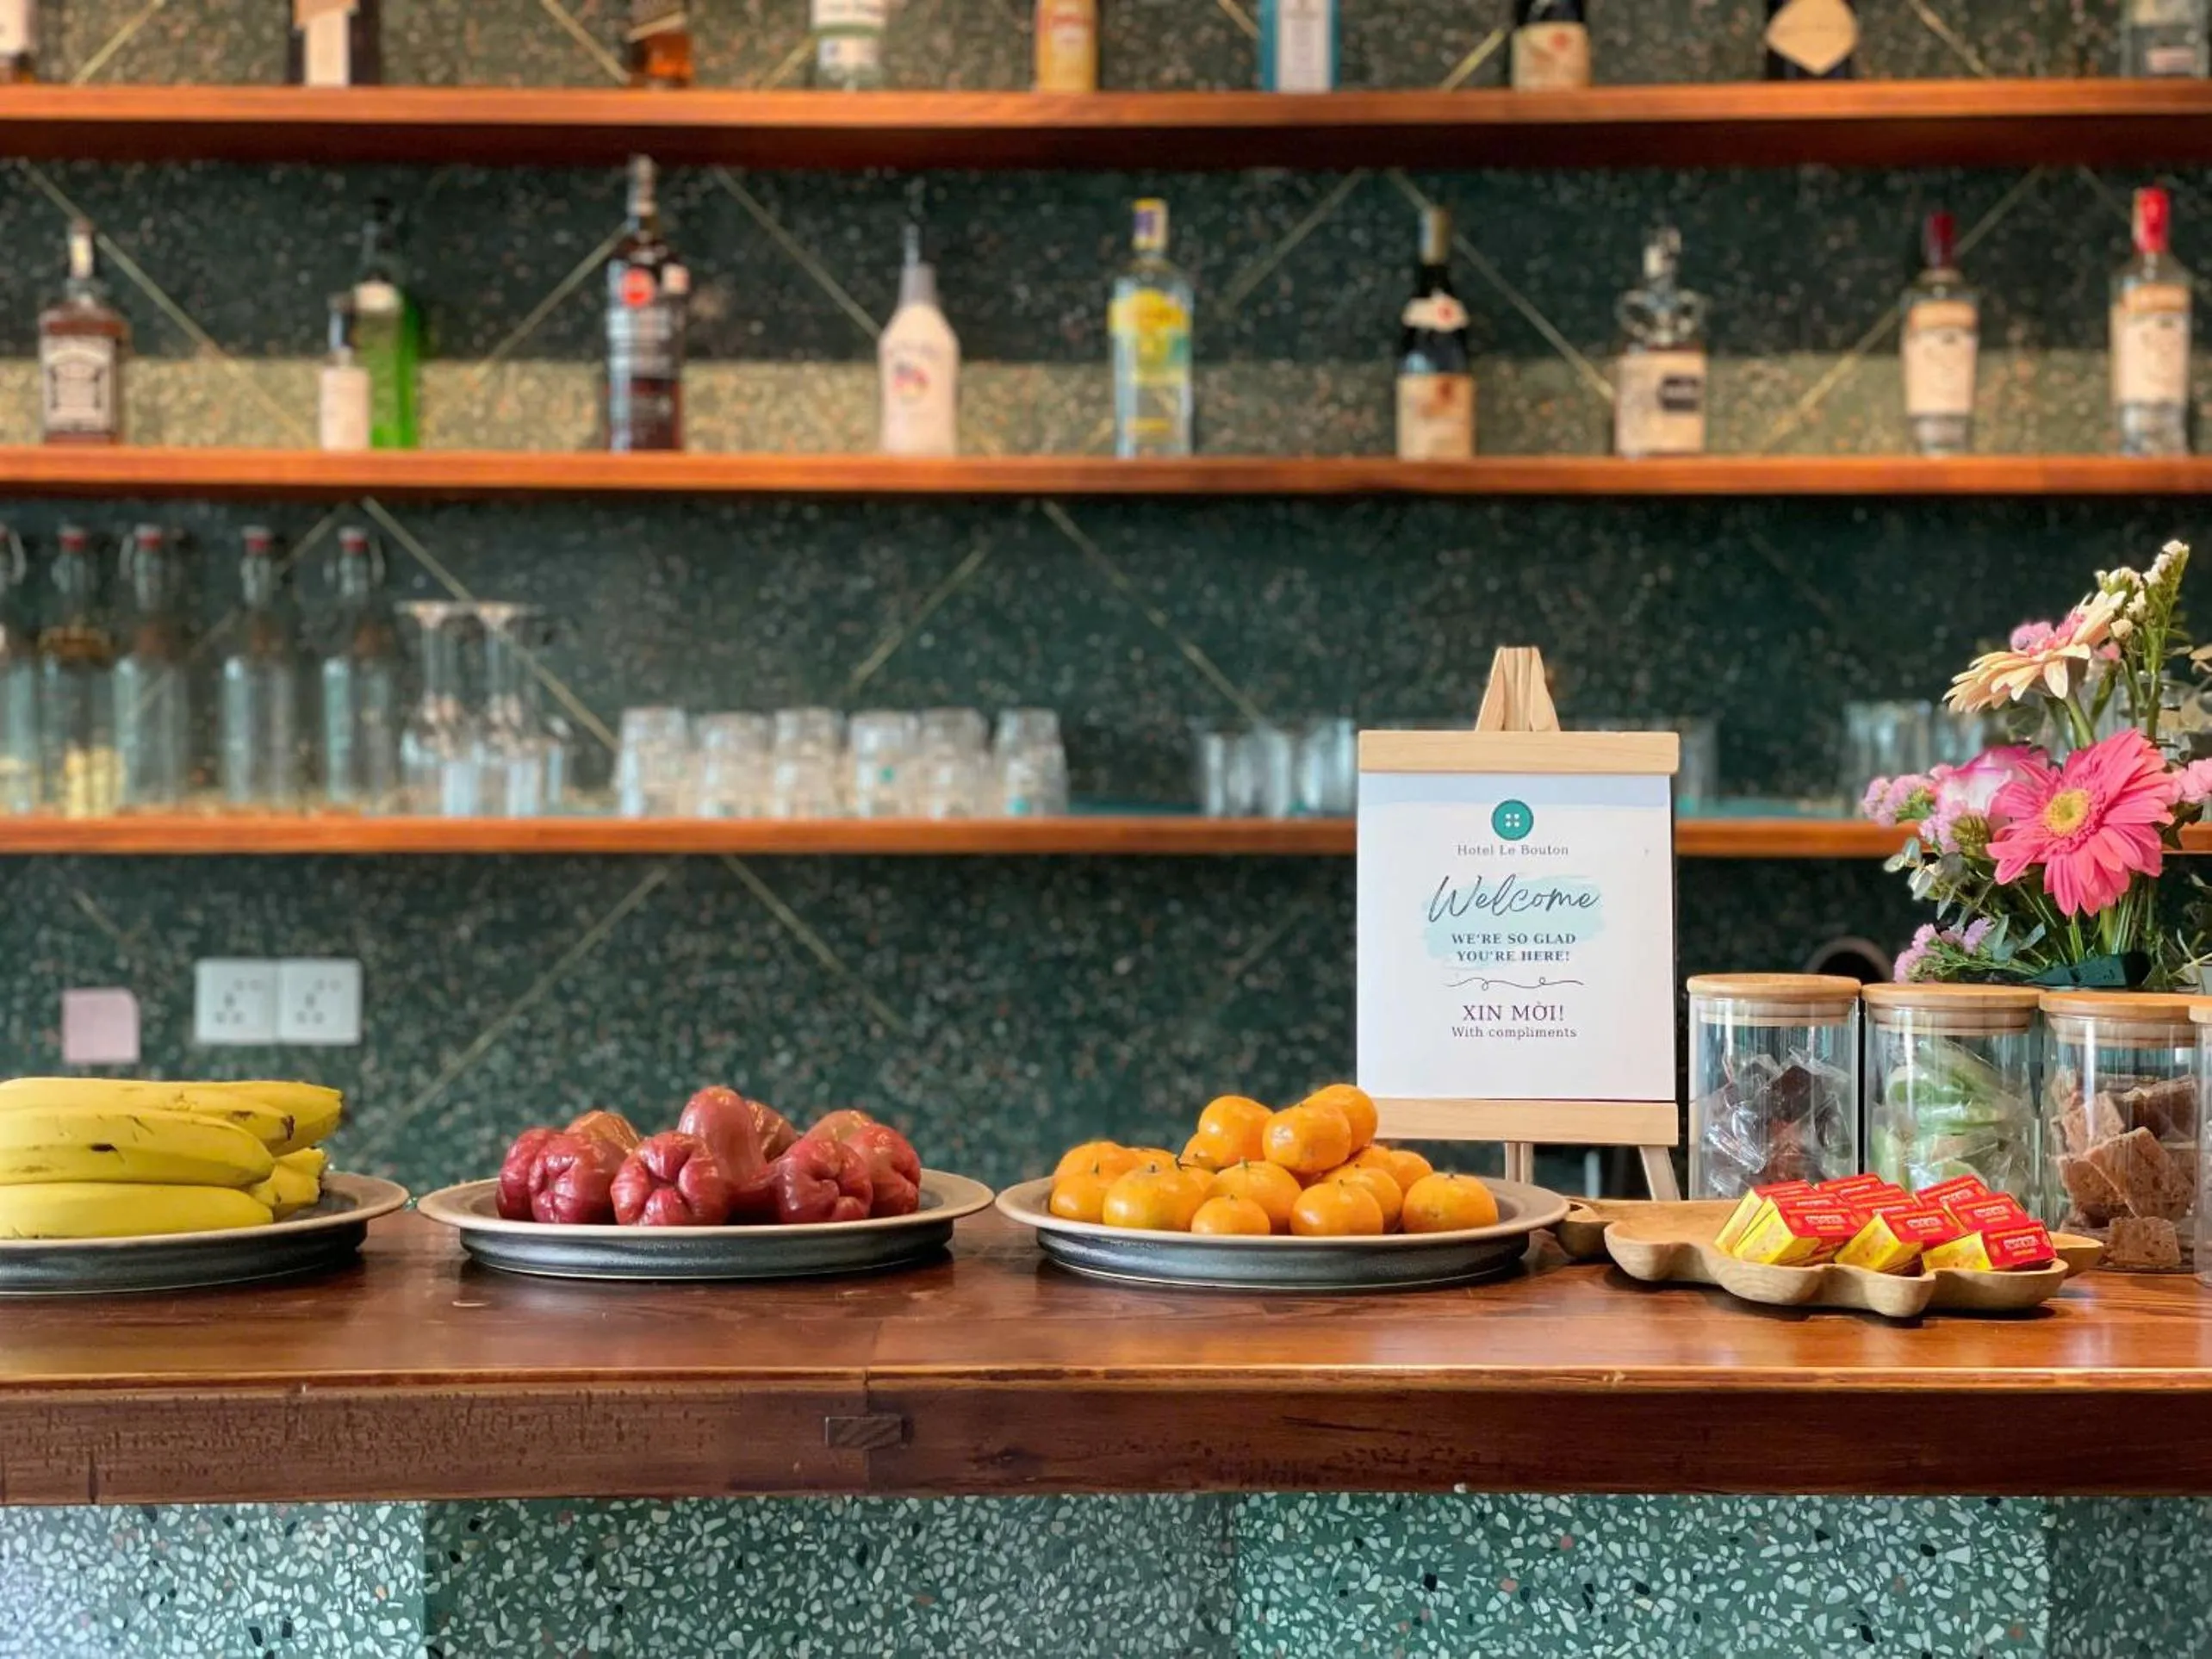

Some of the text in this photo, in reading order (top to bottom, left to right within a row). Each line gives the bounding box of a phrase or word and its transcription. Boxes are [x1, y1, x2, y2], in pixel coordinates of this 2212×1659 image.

[1457, 843, 1569, 855] Hotel Le Bouton
[1428, 873, 1600, 923] Welcome
[1452, 933, 1576, 945] WE'RE SO GLAD
[1457, 949, 1570, 962] YOU'RE HERE!
[1462, 1000, 1565, 1022] XIN MỜI!
[1451, 1025, 1577, 1041] With compliments
